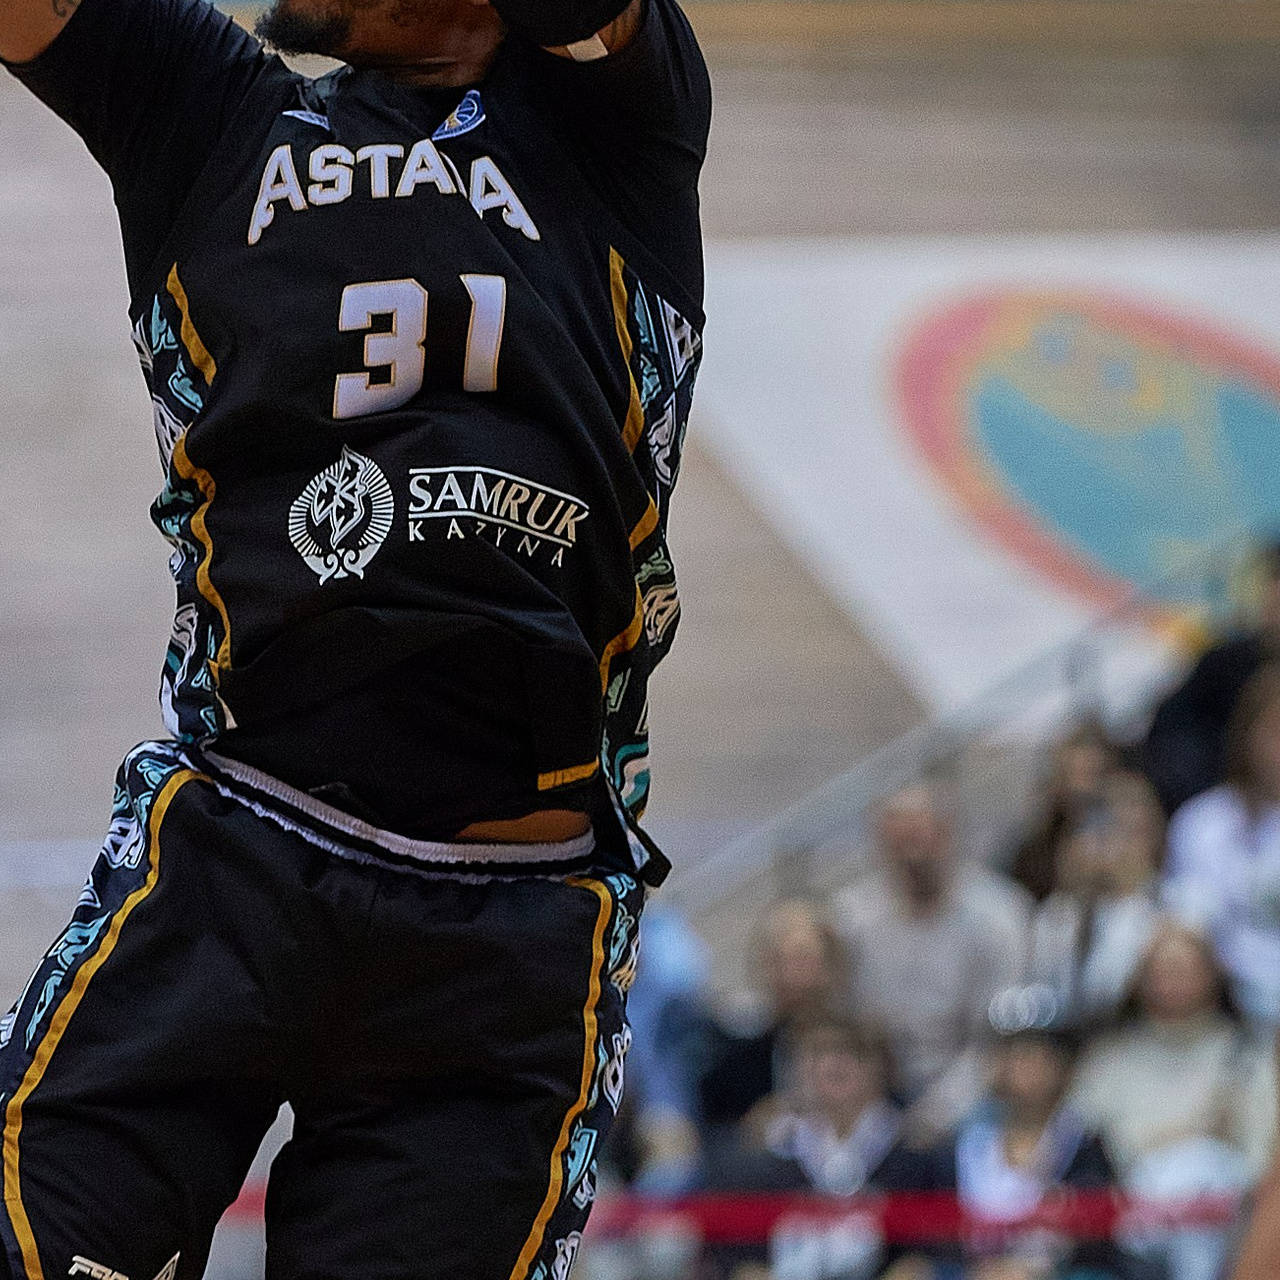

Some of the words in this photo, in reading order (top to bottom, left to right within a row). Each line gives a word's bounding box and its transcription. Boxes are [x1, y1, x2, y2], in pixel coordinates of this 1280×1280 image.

[247, 138, 541, 246] ASTAA
[332, 272, 506, 419] 31
[408, 472, 590, 543] SAMRUK
